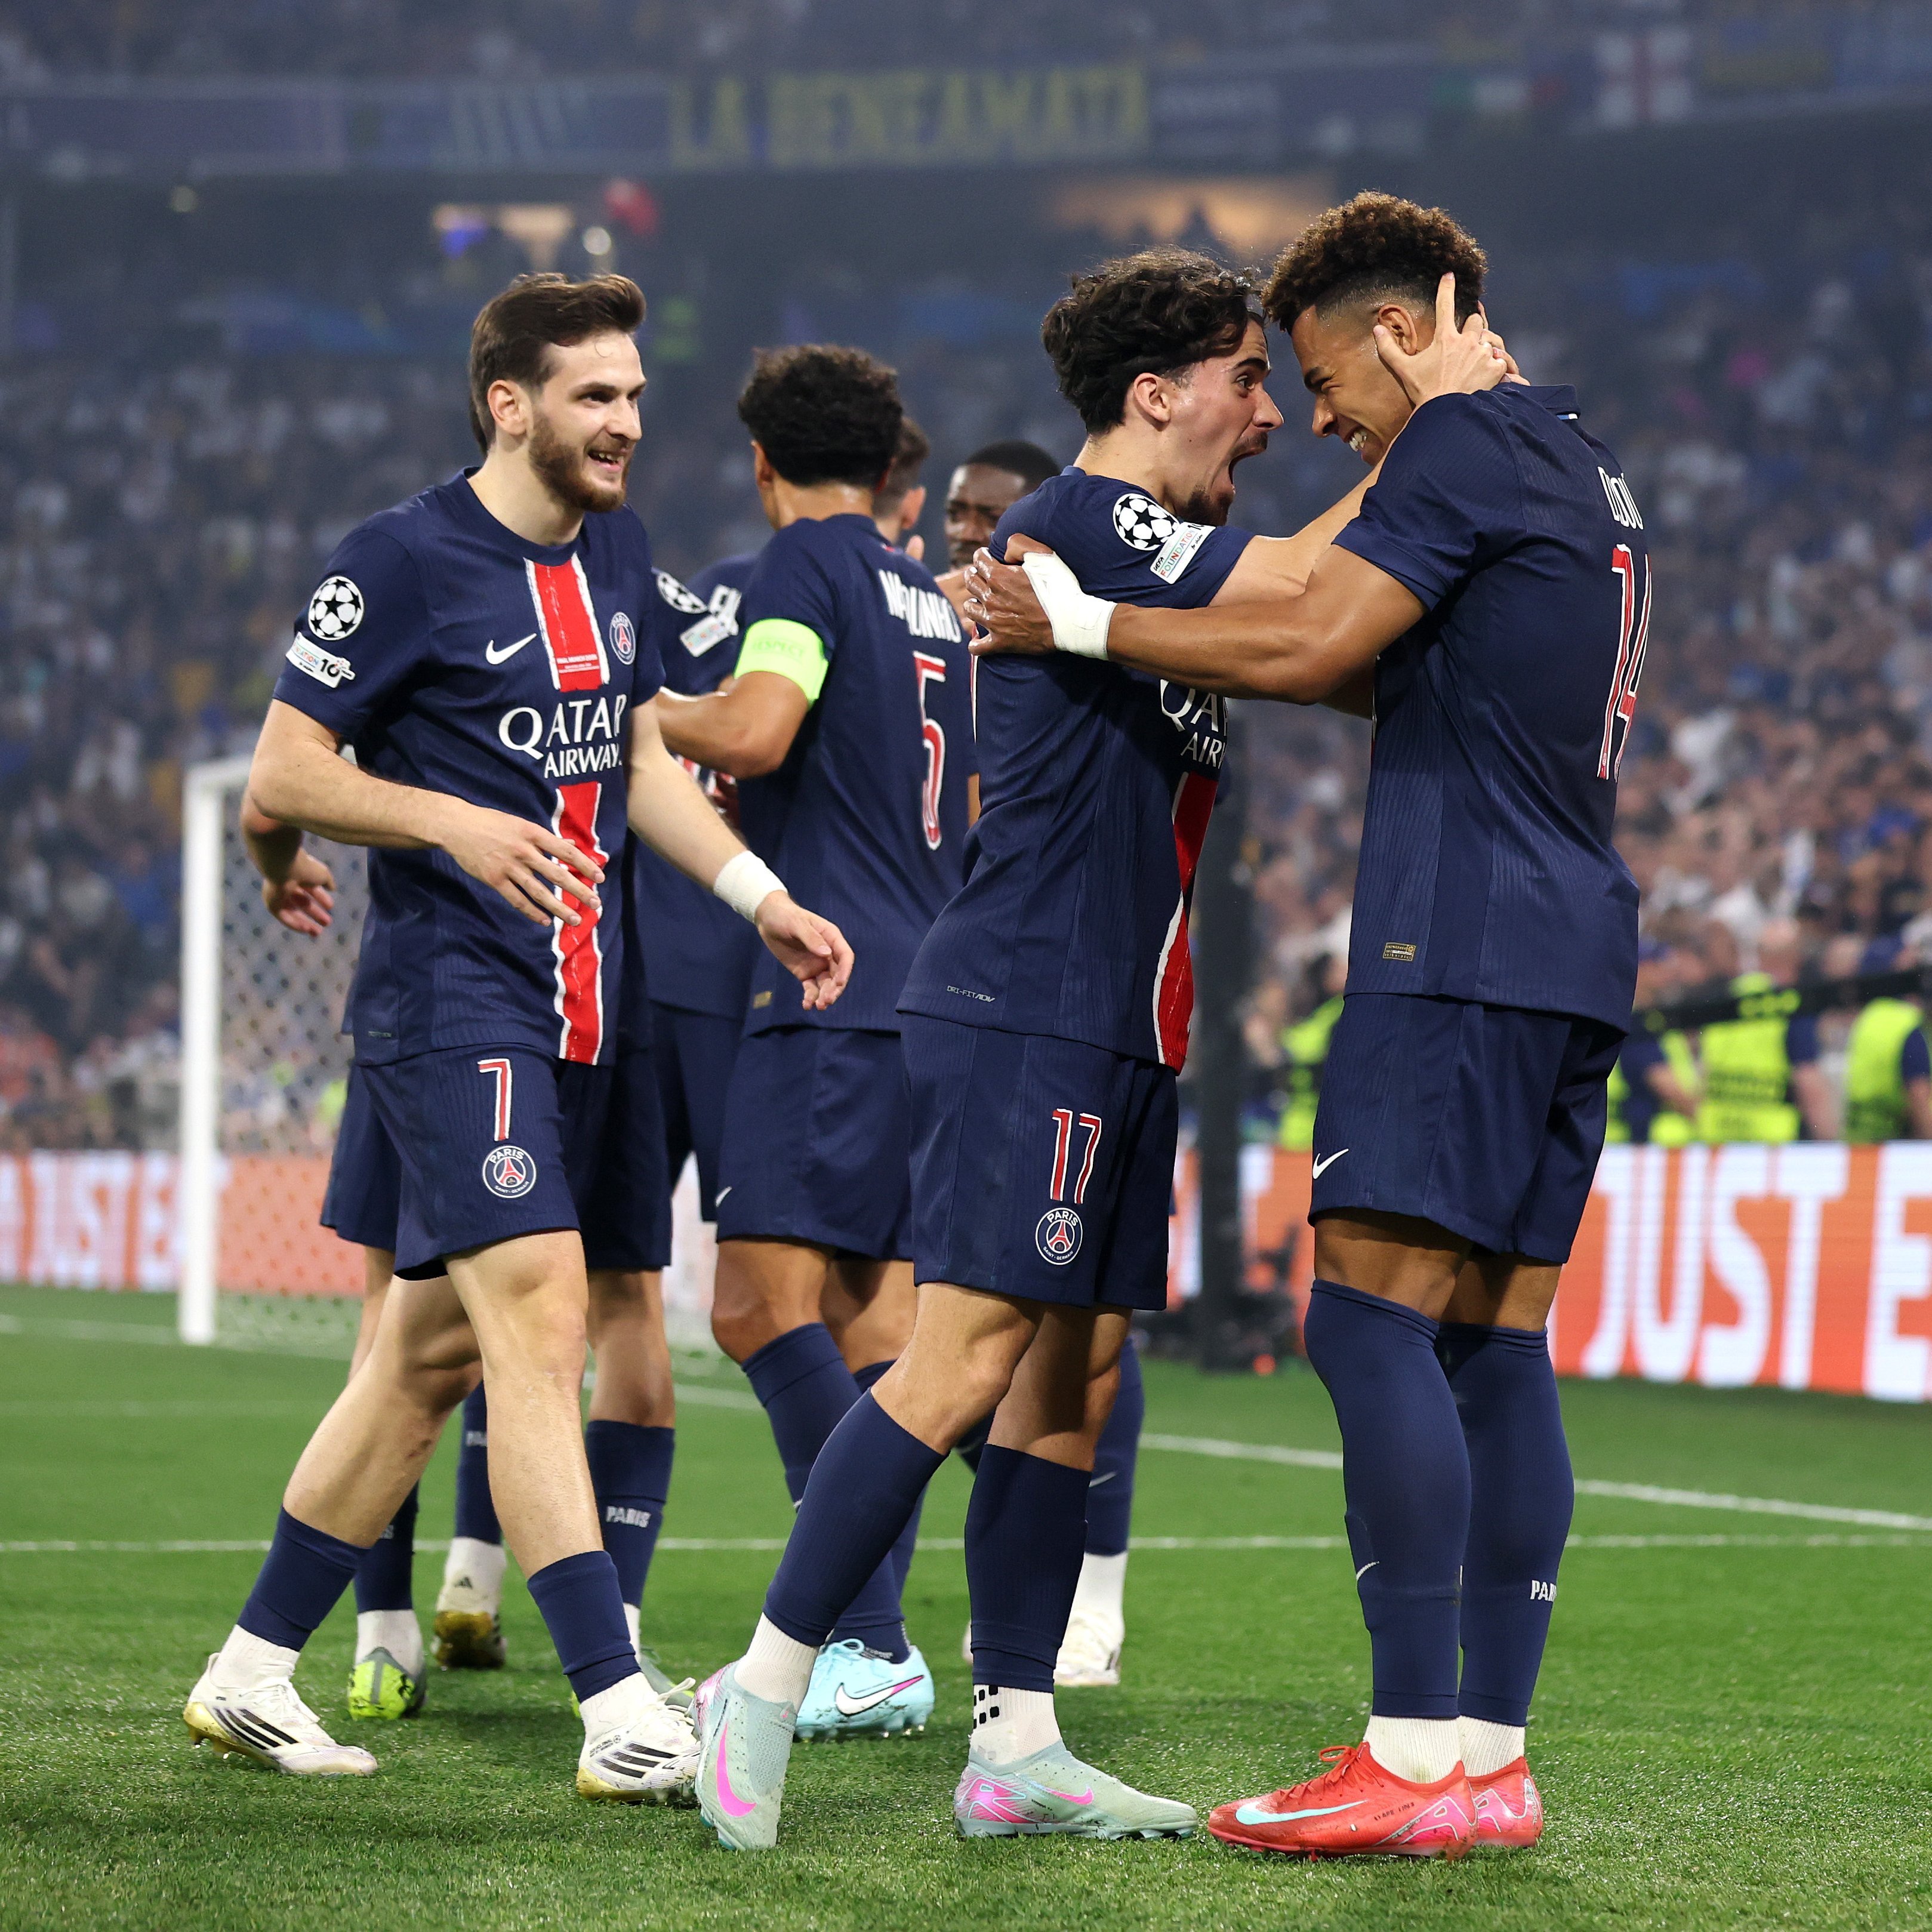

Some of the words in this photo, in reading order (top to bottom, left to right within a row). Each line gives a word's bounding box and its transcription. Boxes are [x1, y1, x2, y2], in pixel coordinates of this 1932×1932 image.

[544, 743, 623, 779] AIRWAY
[913, 651, 945, 850] 5
[477, 1058, 512, 1141] 7
[489, 1148, 525, 1163] PARIS
[1050, 1108, 1102, 1204] 17
[1046, 1210, 1078, 1227] PARIS
[1579, 1145, 1850, 1391] JUST
[606, 1506, 651, 1528] PARIS
[1530, 1580, 1557, 1602] PAR
